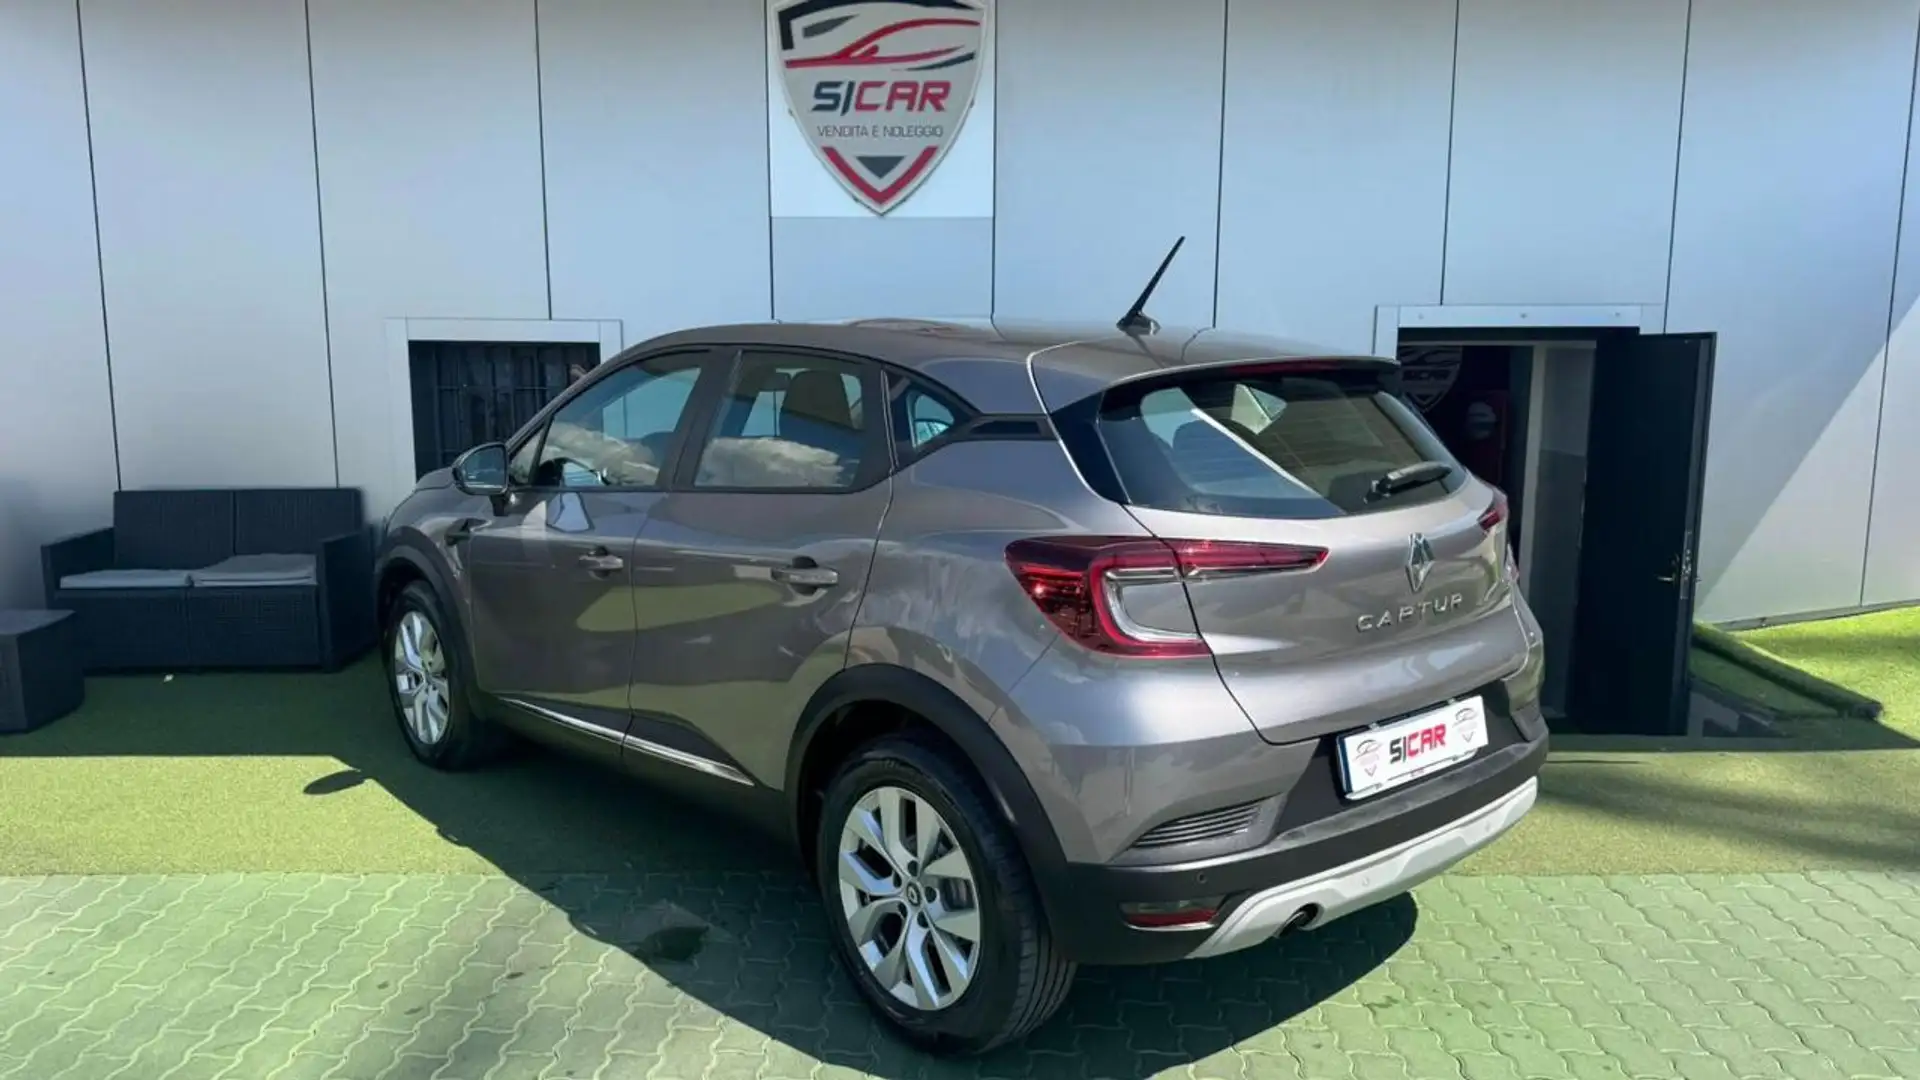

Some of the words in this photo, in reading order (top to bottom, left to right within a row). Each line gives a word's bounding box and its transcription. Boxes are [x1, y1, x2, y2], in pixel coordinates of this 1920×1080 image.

[817, 125, 868, 137] VENDITA
[872, 125, 880, 137] E
[883, 125, 943, 137] NOLEGGIO
[1357, 593, 1463, 631] CAPTUR
